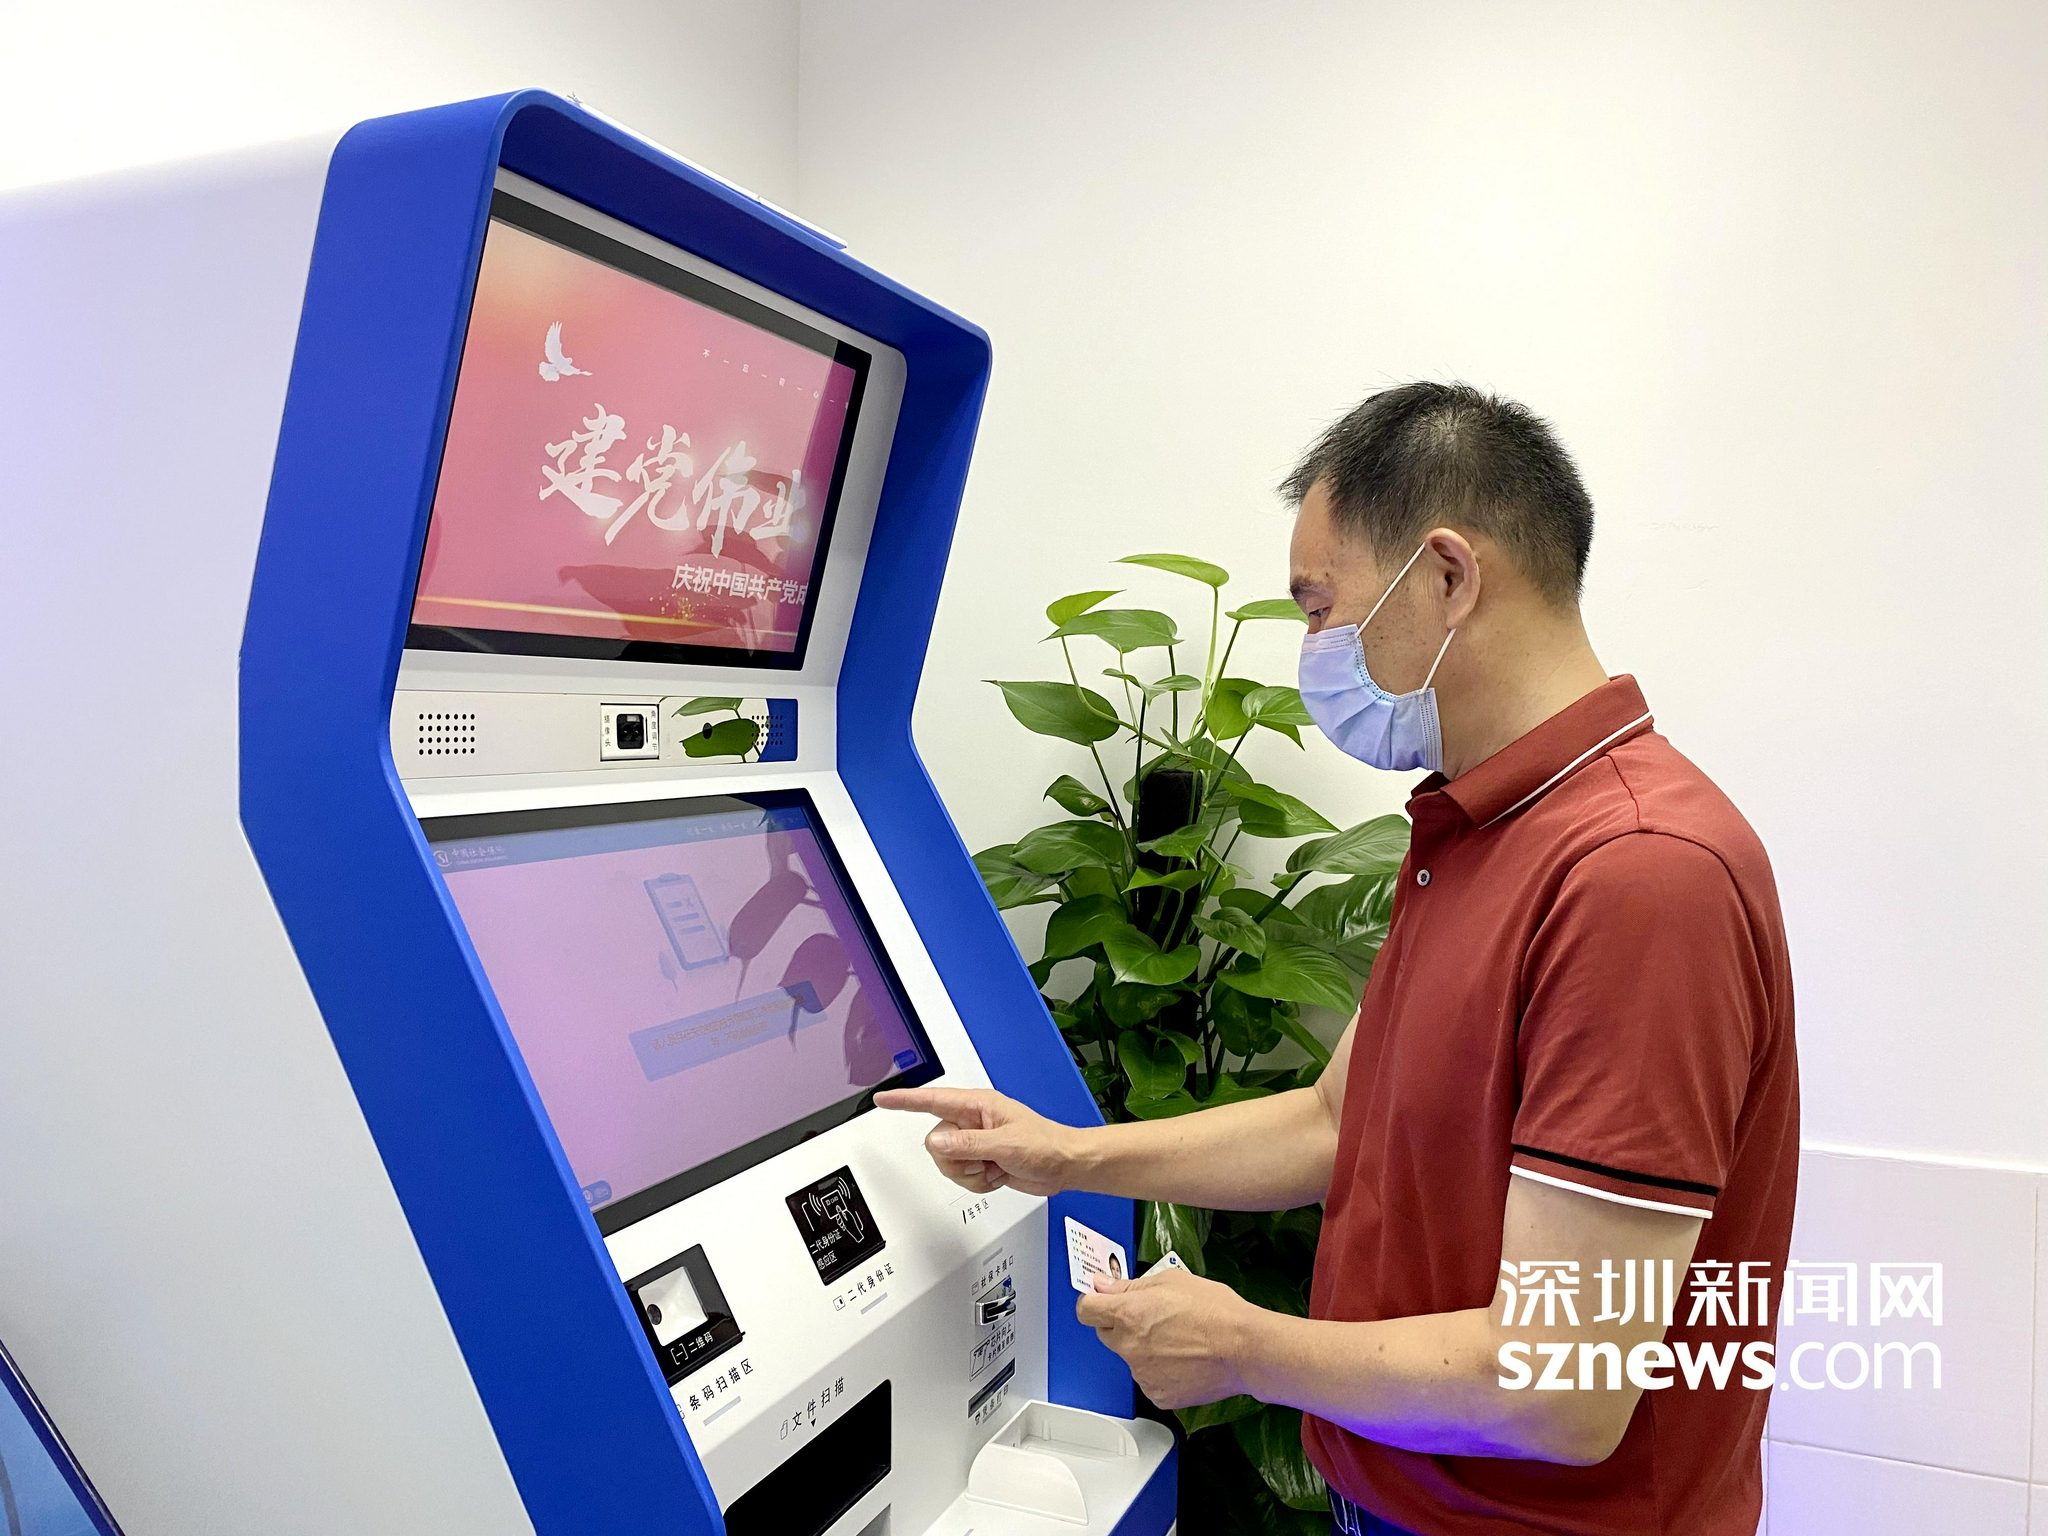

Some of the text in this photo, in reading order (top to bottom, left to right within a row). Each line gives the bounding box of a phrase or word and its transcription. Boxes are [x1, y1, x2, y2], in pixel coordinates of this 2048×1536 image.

[539, 403, 806, 558] 建党伟业
[967, 1197, 990, 1220] 签字区
[809, 1228, 843, 1255] 二代身份证
[816, 1250, 838, 1271] 感应区
[847, 1262, 895, 1302] 二代身份证
[689, 1331, 715, 1354] 二维码
[688, 1358, 755, 1412] 条码扫描区
[791, 1376, 845, 1432] 文件扫描
